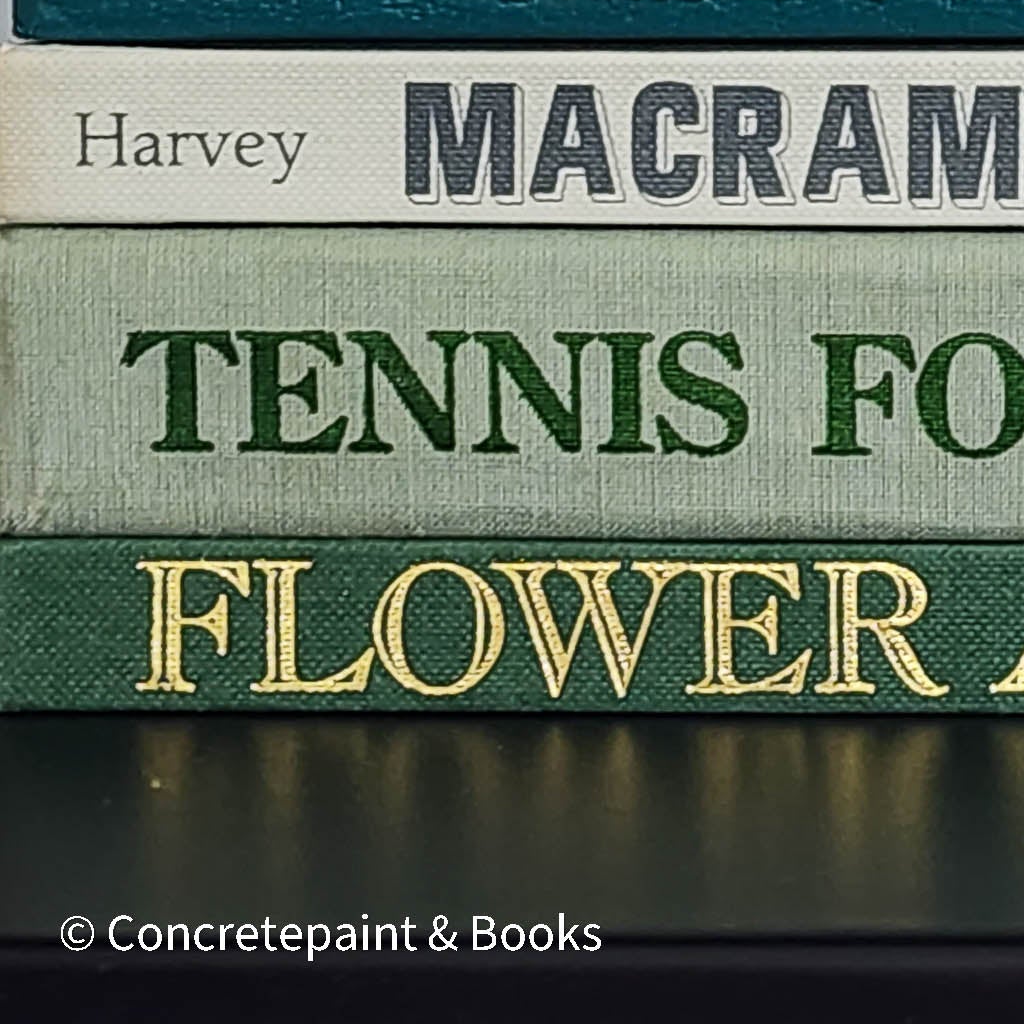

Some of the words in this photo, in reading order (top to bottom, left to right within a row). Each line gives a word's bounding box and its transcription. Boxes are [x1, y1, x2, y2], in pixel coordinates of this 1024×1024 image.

[73, 110, 309, 185] Harvey
[120, 330, 750, 458] TENNIS
[135, 557, 950, 699] FLOWER
